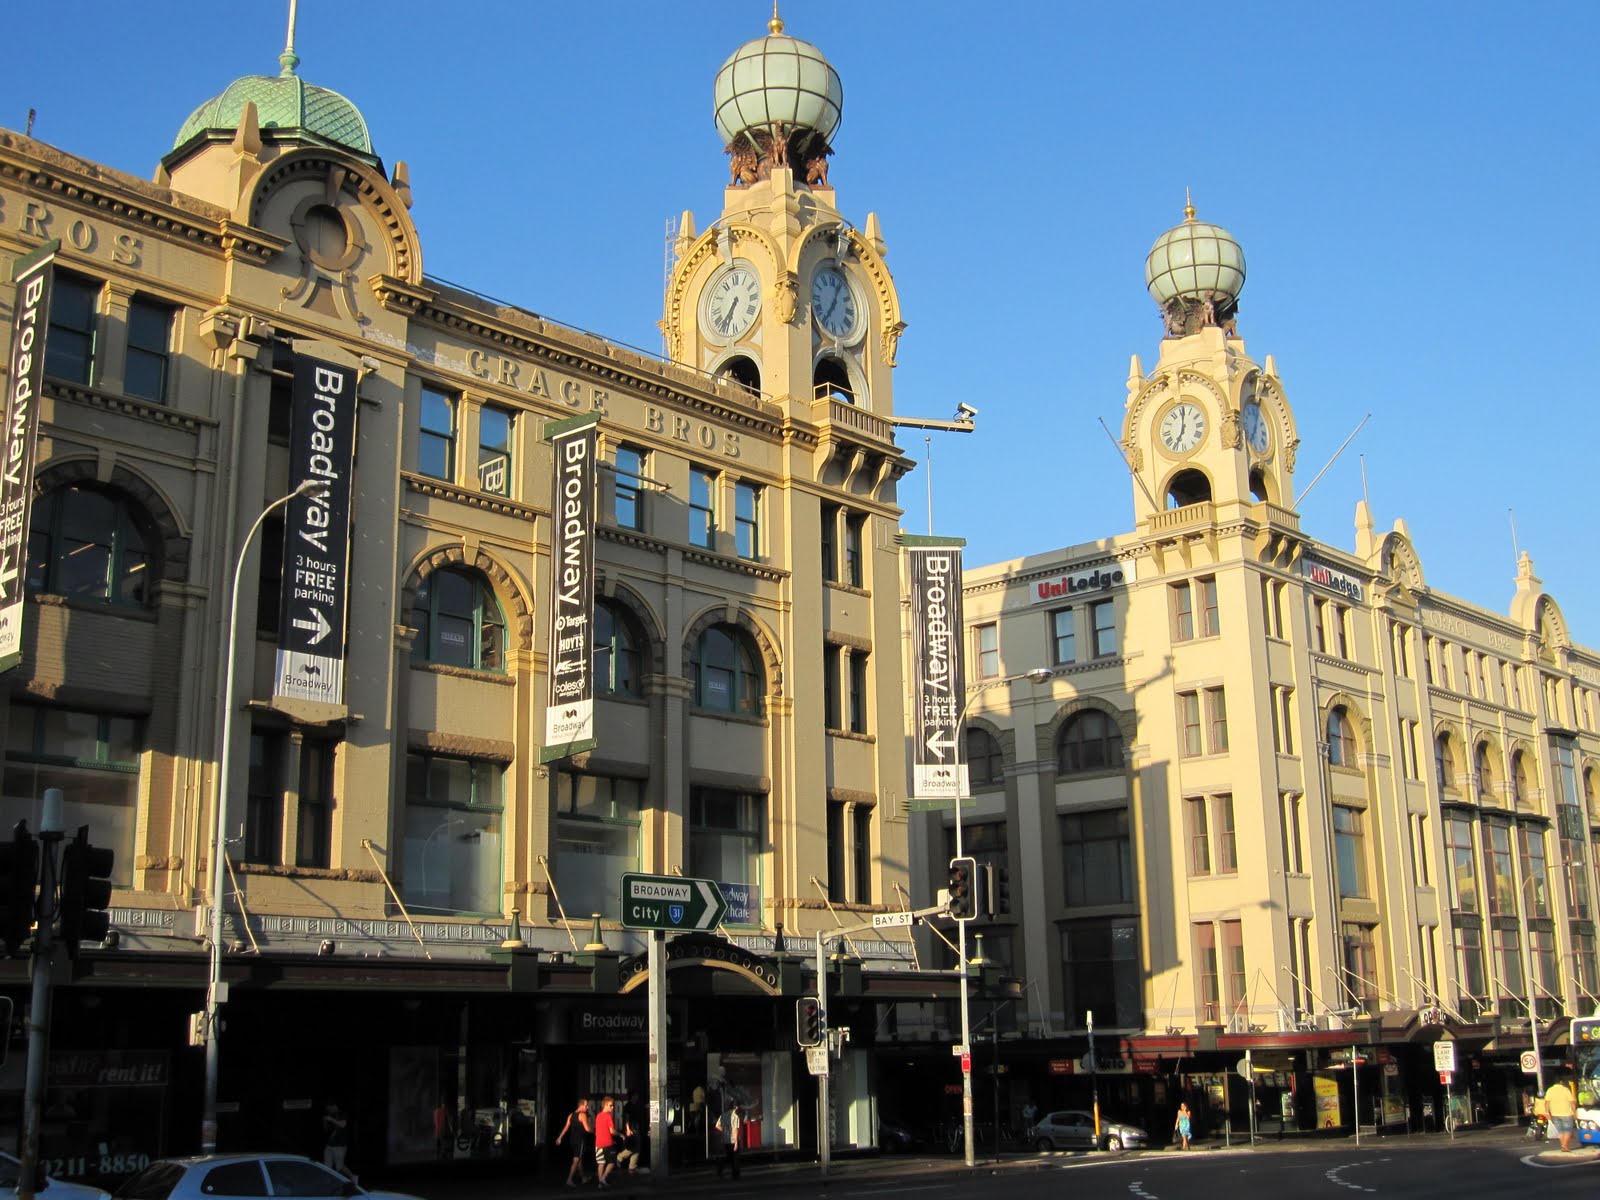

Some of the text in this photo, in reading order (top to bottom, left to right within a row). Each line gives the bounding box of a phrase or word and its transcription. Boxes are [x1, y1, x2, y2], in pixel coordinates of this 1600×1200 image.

[4, 275, 44, 485] Broadway
[465, 349, 740, 457] GRACE BROS
[559, 438, 586, 606] Broadway
[296, 555, 337, 573] 3 hours
[295, 569, 336, 591] FREE
[1038, 570, 1123, 599] UniLodge
[1311, 564, 1359, 596] UniLodge
[294, 587, 335, 606] parking
[925, 556, 952, 692] Broadway
[560, 635, 584, 651] HOYTS
[285, 674, 333, 693] Broadway
[924, 695, 956, 703] 3 hours
[925, 706, 957, 716] FREE
[553, 720, 586, 734] Broadway
[925, 718, 957, 727] parking
[923, 780, 960, 788] Broadwa
[633, 885, 688, 898] BROADWAY
[633, 906, 660, 922] City
[875, 914, 909, 925] BAY ST
[583, 1012, 645, 1029] Broadway
